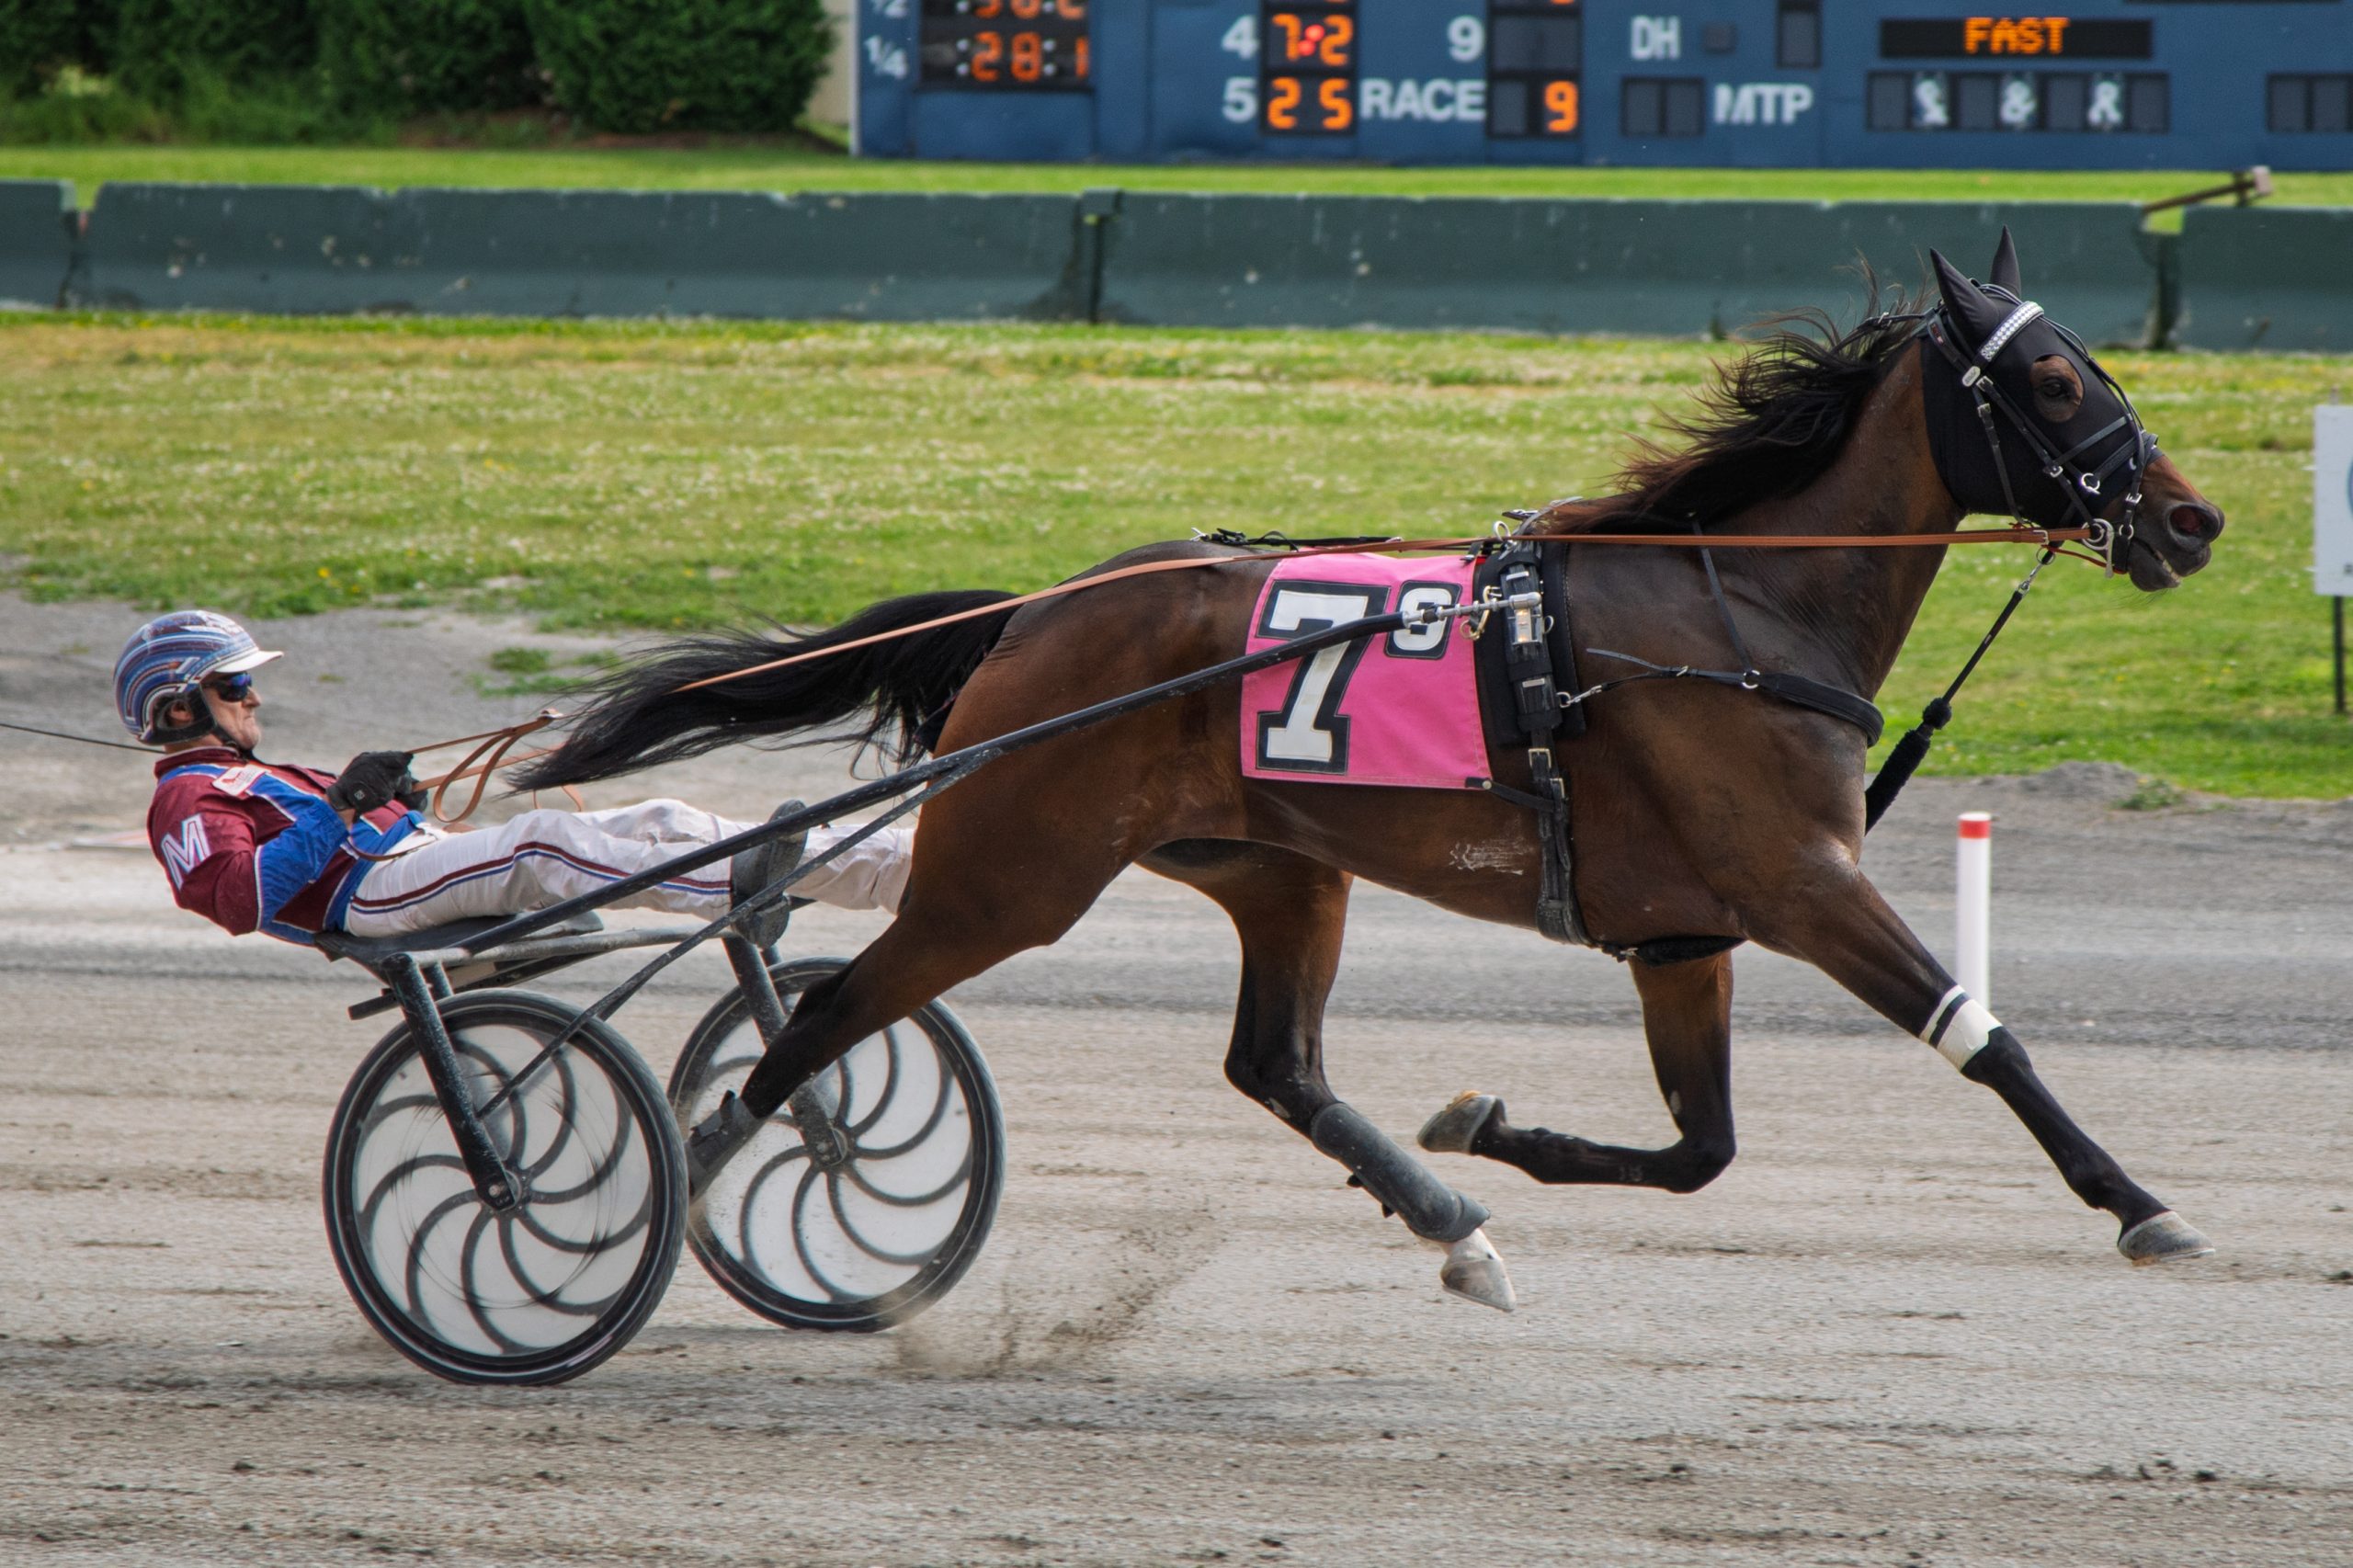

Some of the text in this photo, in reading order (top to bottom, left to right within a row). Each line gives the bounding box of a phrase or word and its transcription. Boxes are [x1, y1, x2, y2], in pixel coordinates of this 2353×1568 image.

[1222, 15, 1258, 59] 4
[1448, 15, 1484, 62] 9
[1631, 15, 1680, 60] DH
[1963, 17, 2070, 53] FAST
[1222, 76, 1257, 122] 5
[1359, 78, 1486, 121] RACE
[1544, 80, 1578, 132] 9
[1713, 83, 1813, 124] MTP
[1261, 584, 1381, 769] 7
[160, 812, 212, 892] M
